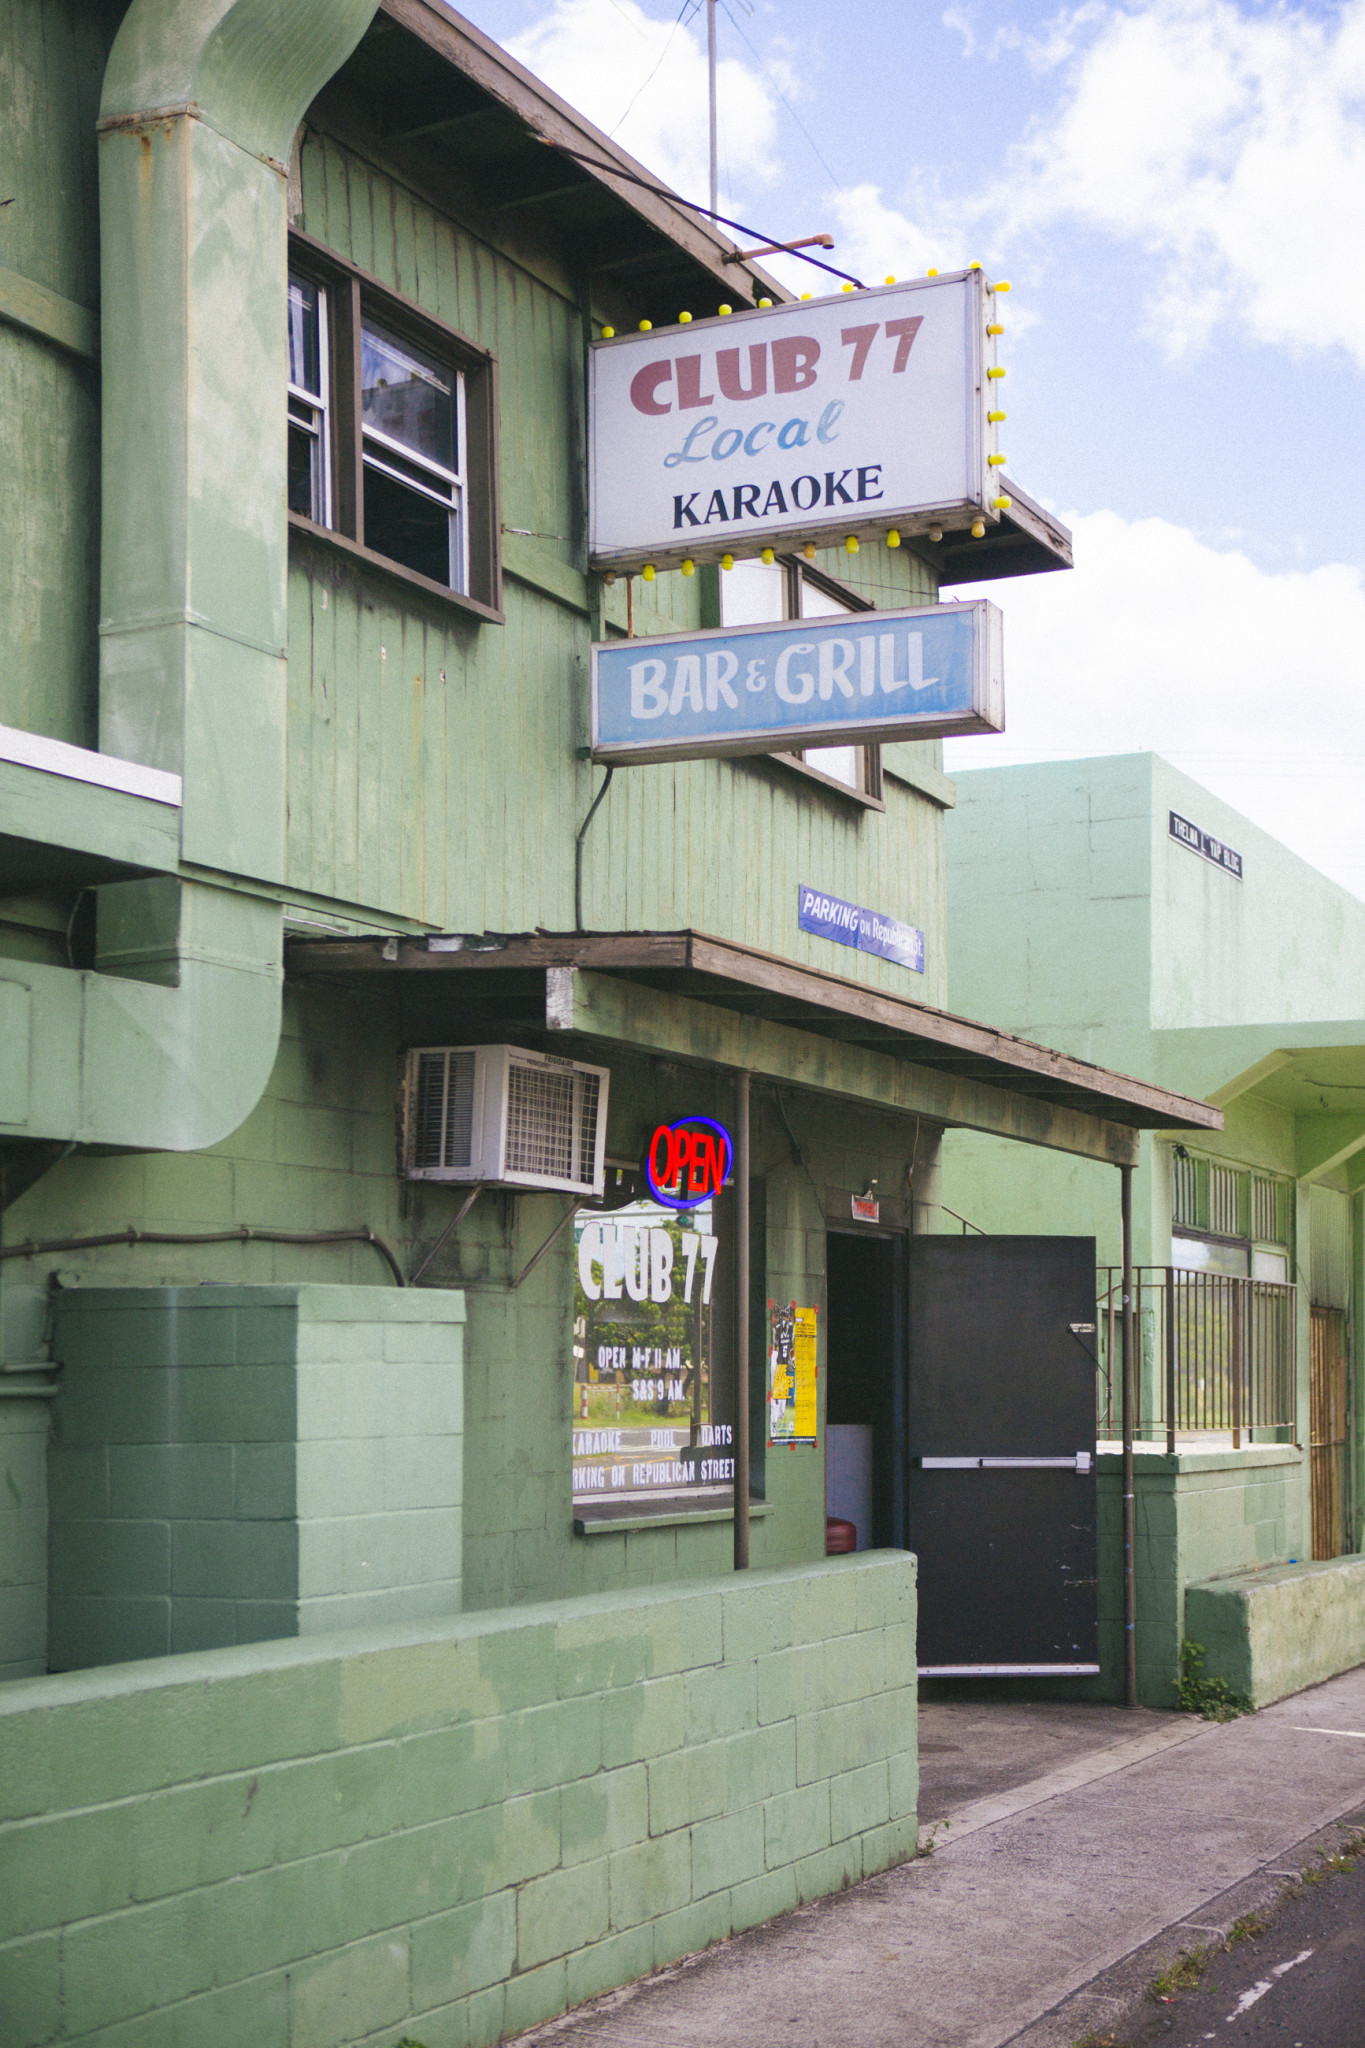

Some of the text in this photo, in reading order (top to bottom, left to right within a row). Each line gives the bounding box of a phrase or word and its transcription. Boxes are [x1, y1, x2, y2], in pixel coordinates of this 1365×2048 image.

[629, 315, 925, 416] CLUB 77
[663, 398, 846, 468] Local
[672, 464, 884, 530] KARAOKE
[627, 631, 940, 719] BAR & GRILL
[803, 892, 859, 932] PARKING
[649, 1125, 726, 1195] OPEN
[578, 1221, 719, 1305] CLUB 77
[598, 1345, 626, 1369] OPEN
[632, 1346, 652, 1369] M-F
[632, 1378, 655, 1401] S&S
[657, 1378, 665, 1401] 9
[650, 1429, 676, 1449] POOL
[701, 1424, 733, 1446] DARTS
[611, 1464, 625, 1486] ON
[632, 1460, 695, 1485] REPUBLICAN
[700, 1458, 735, 1481] STREET
